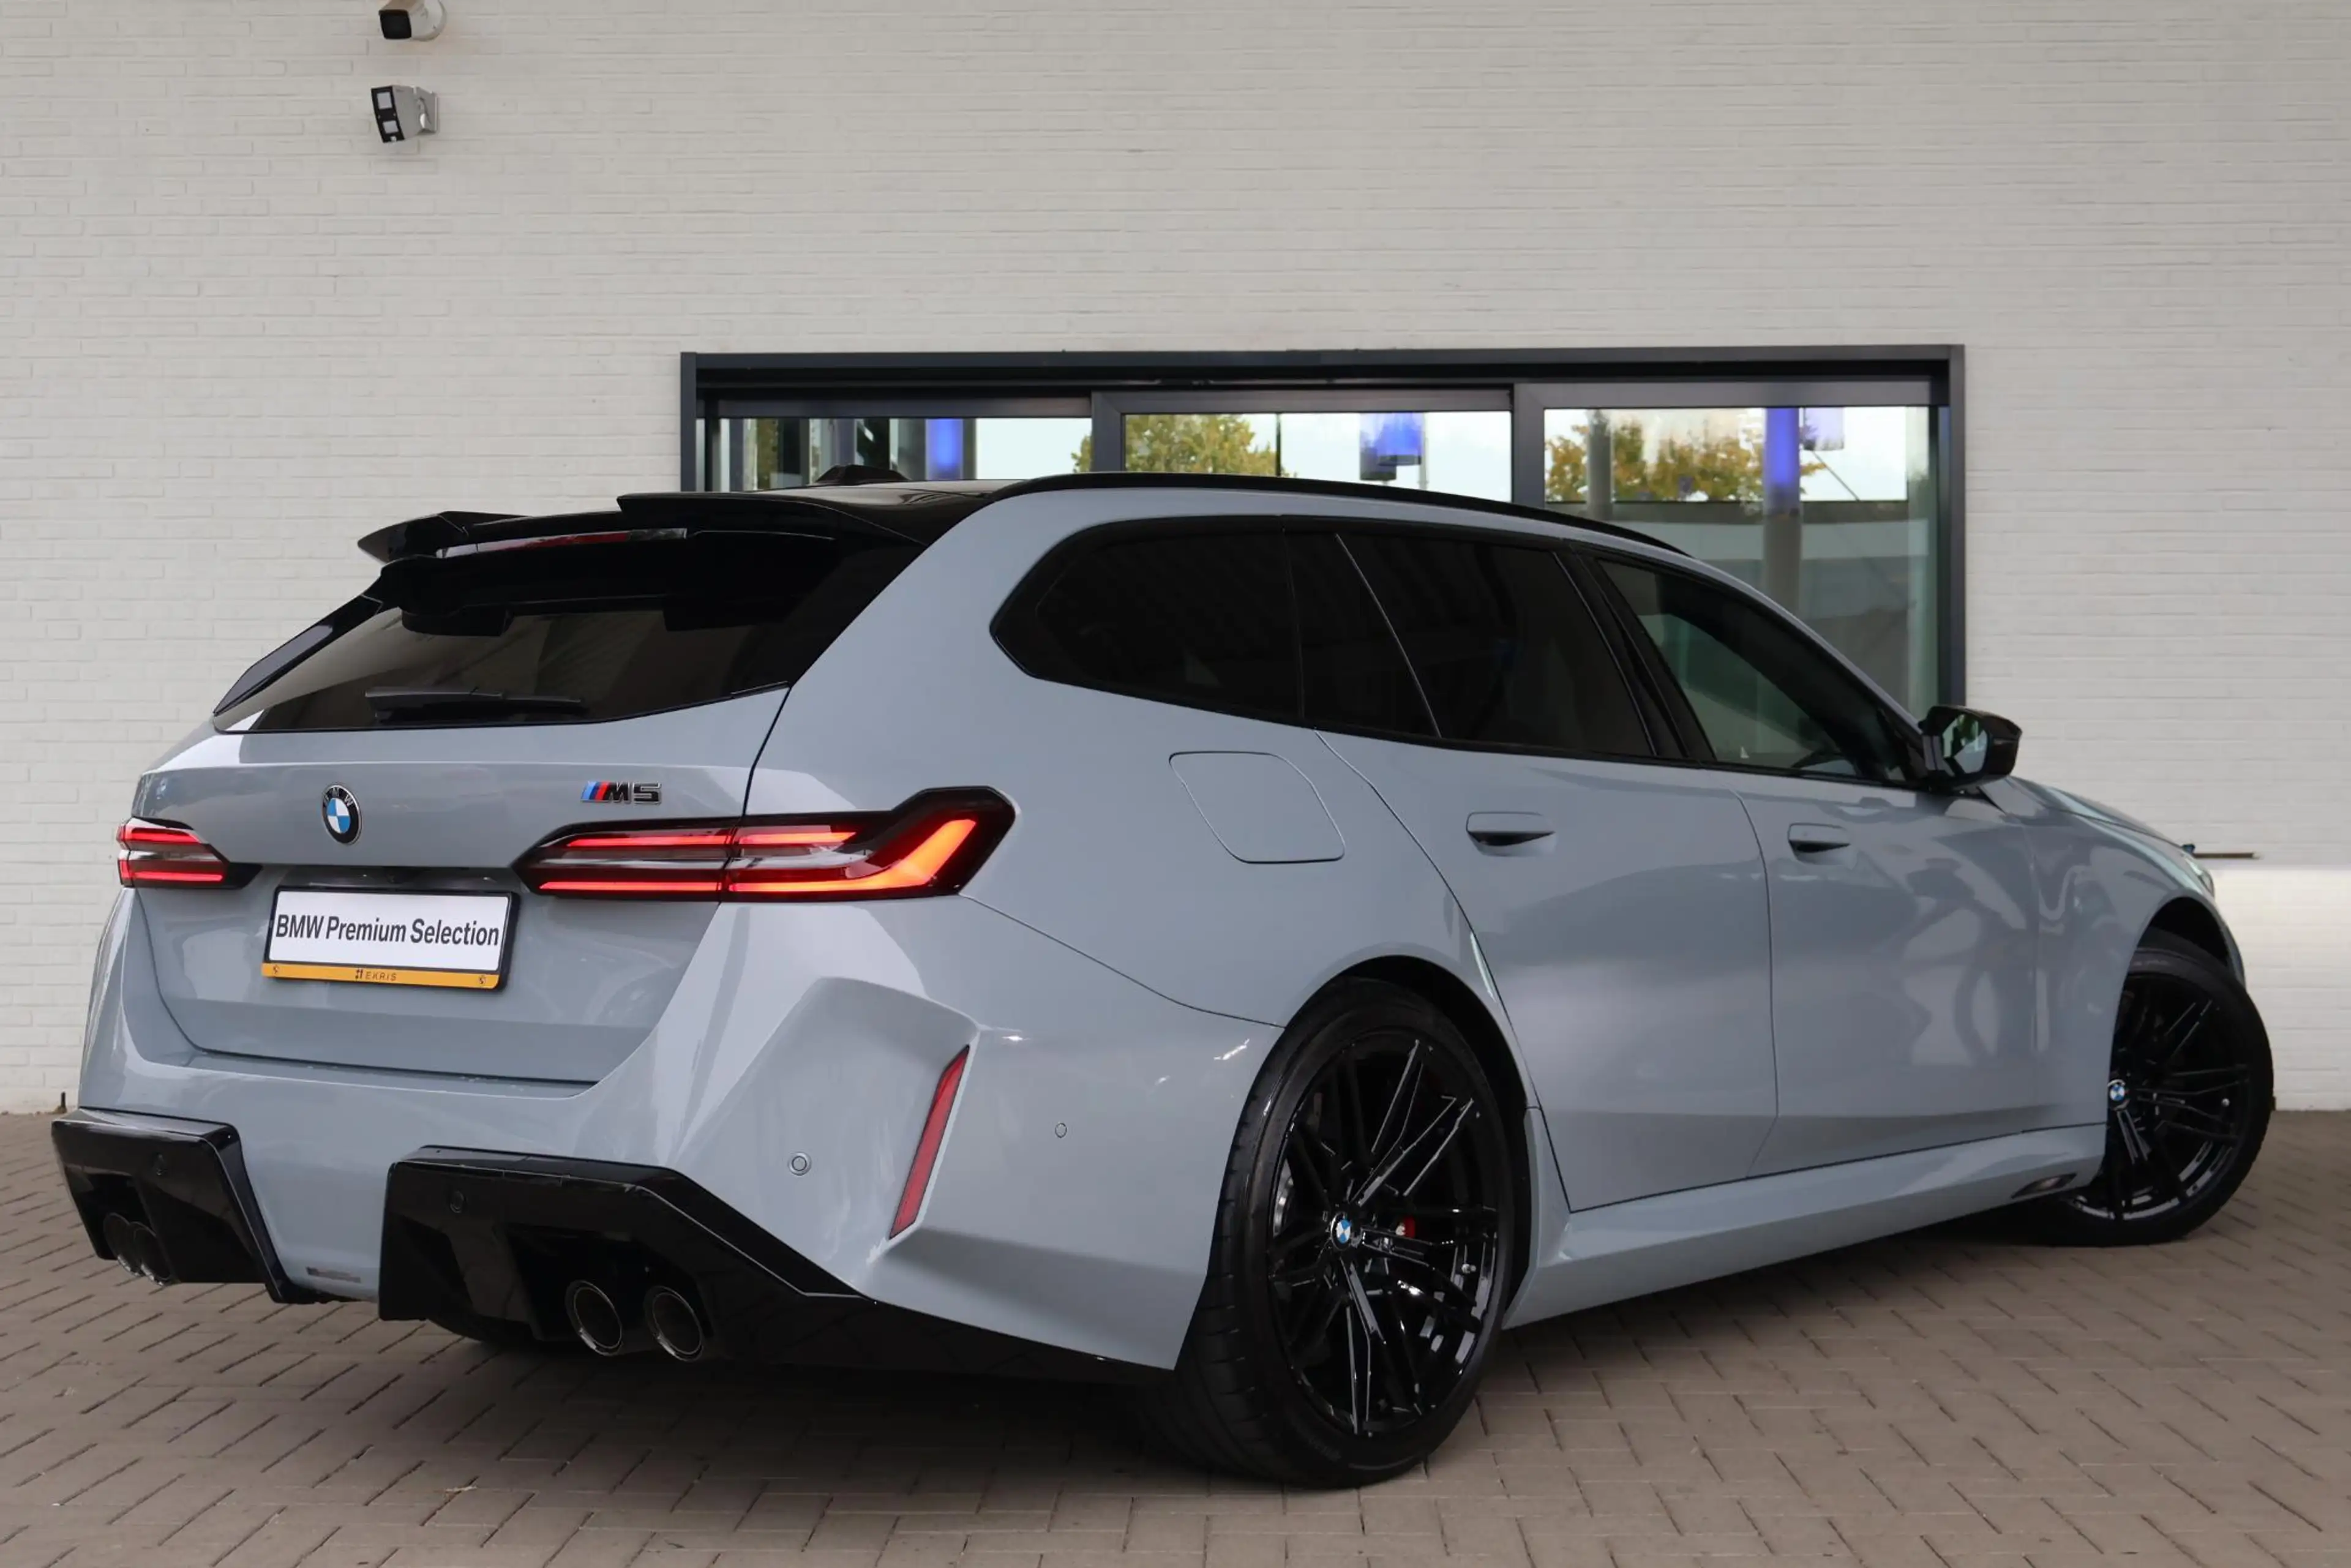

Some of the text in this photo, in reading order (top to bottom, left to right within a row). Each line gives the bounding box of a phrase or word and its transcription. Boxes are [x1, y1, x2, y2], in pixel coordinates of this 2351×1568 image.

[602, 781, 661, 805] M5
[276, 914, 499, 946] BMW Premium Selection
[365, 971, 397, 981] EKRIS
